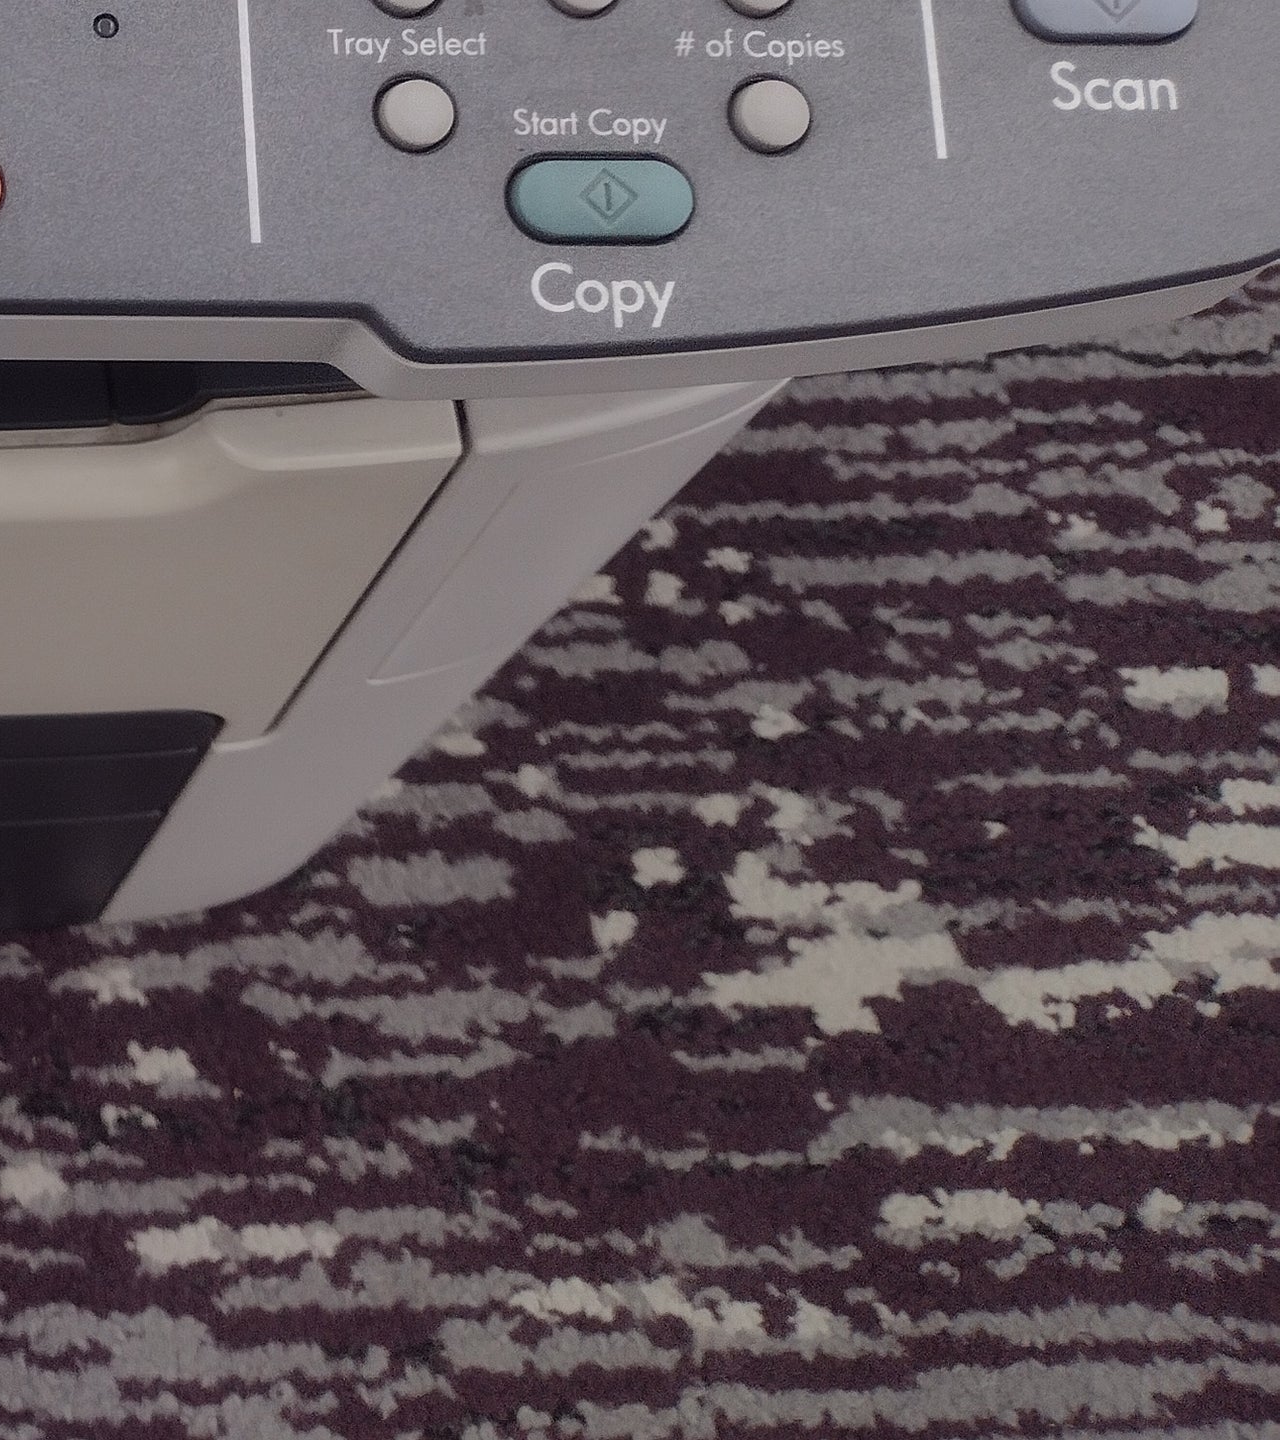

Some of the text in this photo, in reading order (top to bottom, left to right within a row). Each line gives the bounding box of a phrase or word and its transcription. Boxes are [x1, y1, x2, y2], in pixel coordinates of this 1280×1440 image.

[326, 26, 487, 64] Tray Select
[675, 28, 845, 66] # of Copies
[1050, 60, 1178, 111] Scan
[513, 108, 667, 144] Start Copy
[530, 261, 676, 329] Copy
